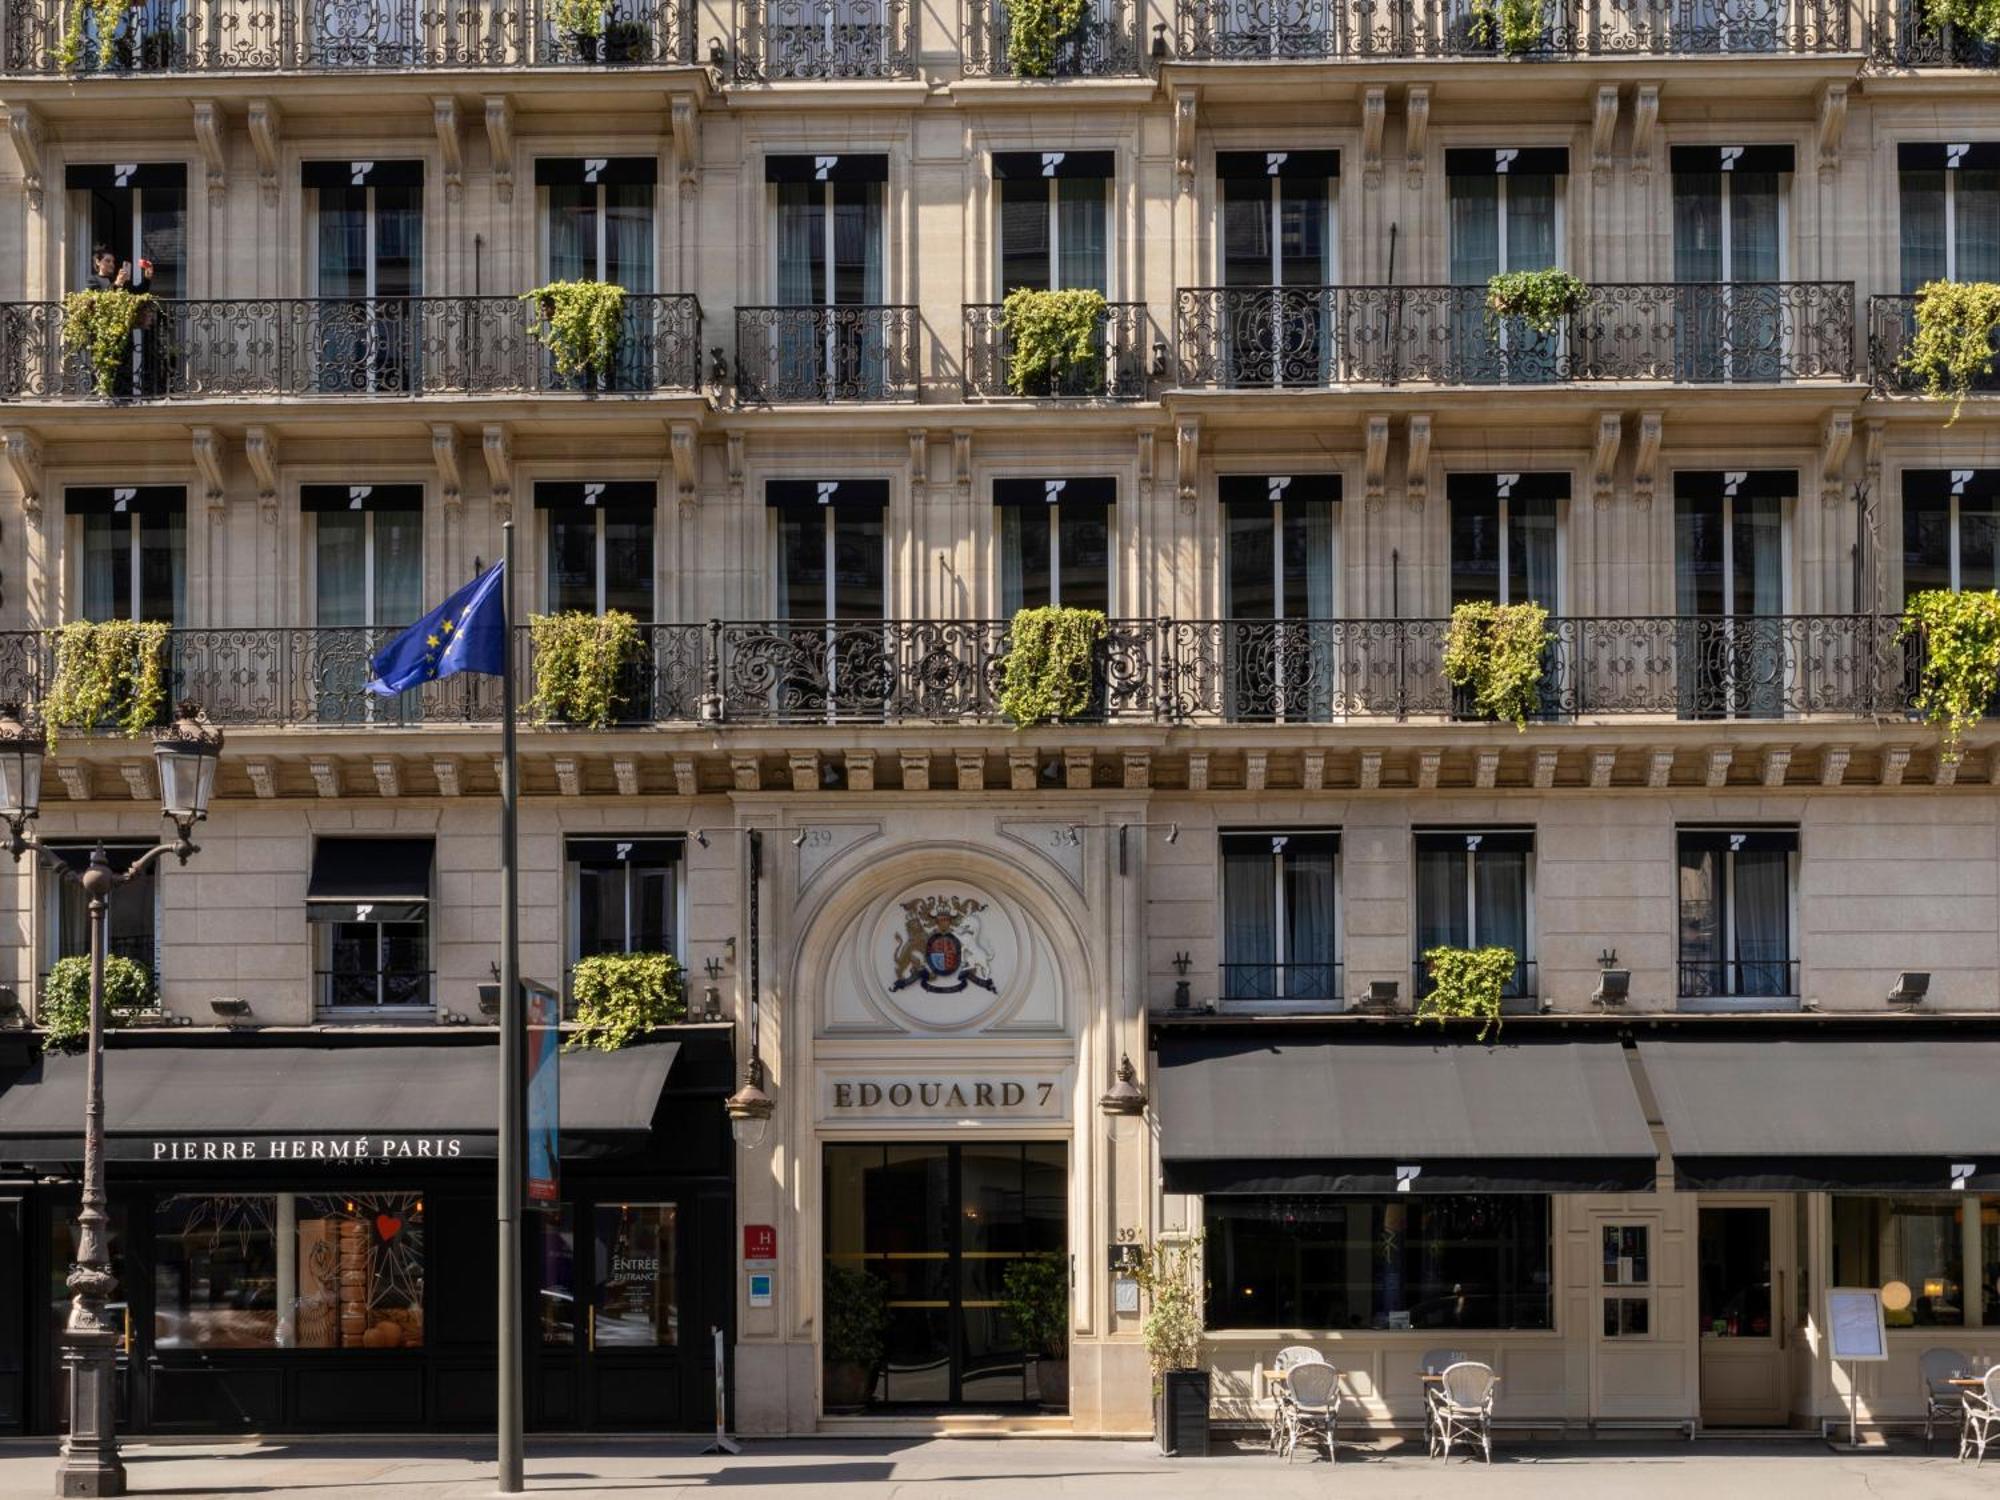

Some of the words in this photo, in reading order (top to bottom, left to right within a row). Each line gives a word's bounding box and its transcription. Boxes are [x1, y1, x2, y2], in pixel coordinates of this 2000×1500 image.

[809, 831, 832, 848] 39
[833, 1082, 1026, 1107] EDOUARD
[1036, 1082, 1055, 1106] 7
[153, 1141, 256, 1160] PIERRE
[270, 1137, 370, 1159] HERMÉ
[382, 1139, 462, 1158] PARIS
[760, 1231, 771, 1244] H
[1117, 1228, 1136, 1242] 39
[614, 1257, 659, 1271] ENTRÉE
